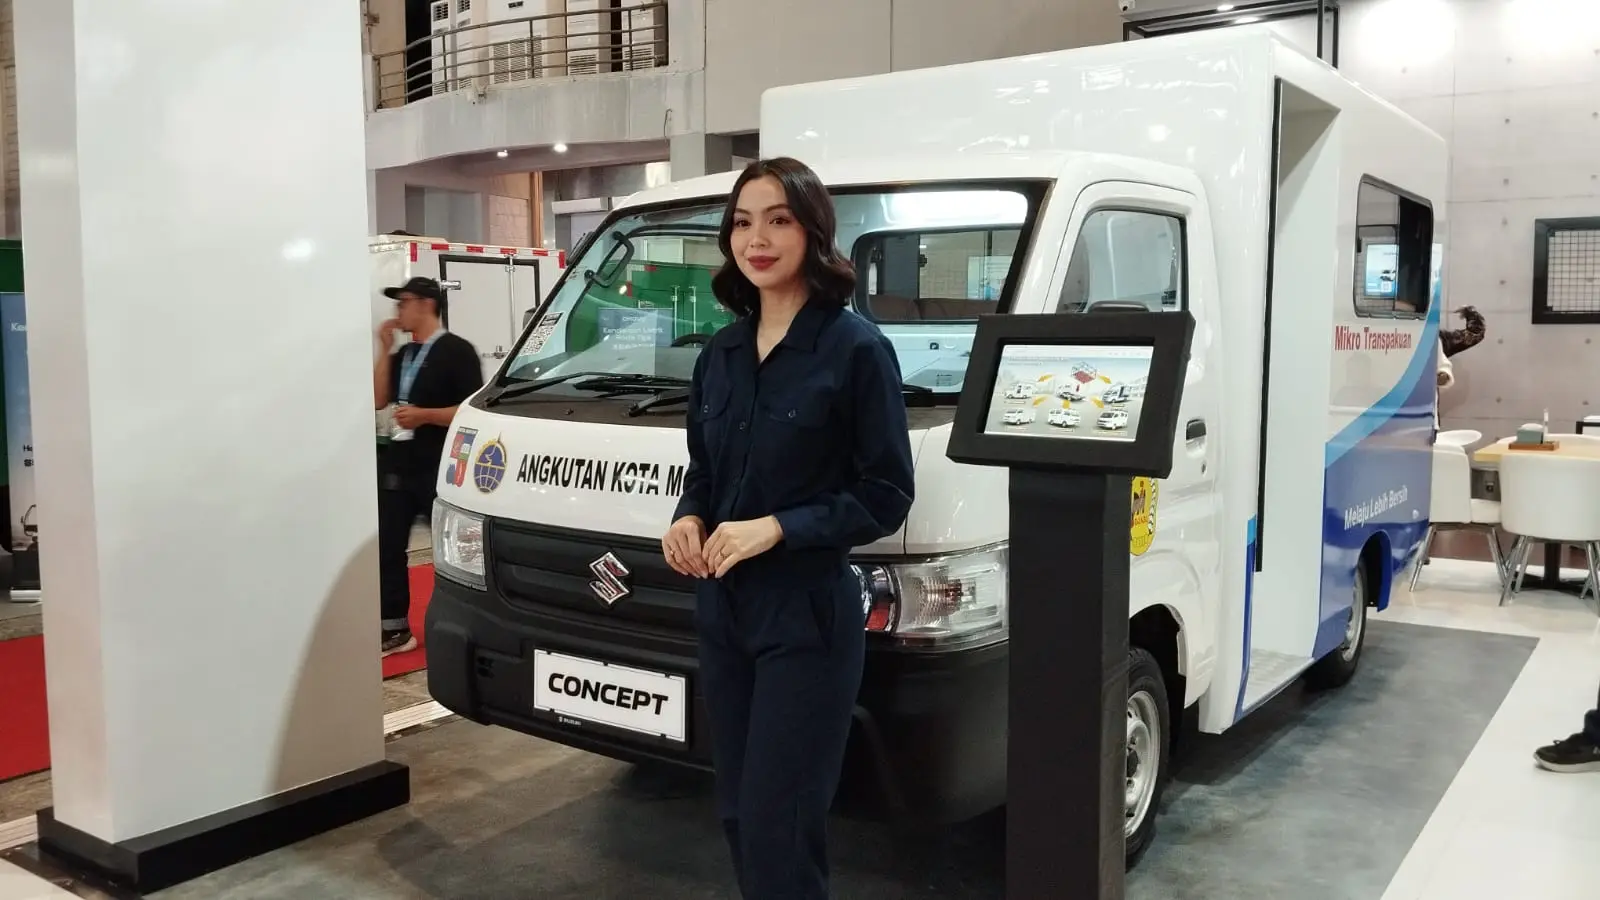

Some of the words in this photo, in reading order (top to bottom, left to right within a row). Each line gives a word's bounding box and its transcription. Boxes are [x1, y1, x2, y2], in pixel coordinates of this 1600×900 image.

[1334, 325, 1361, 351] Mikro
[1363, 326, 1412, 354] Transpakuan
[516, 453, 609, 491] ANGKUTAN
[611, 461, 660, 496] KOTA
[665, 464, 684, 497] M
[1344, 500, 1370, 531] Melaju
[1370, 492, 1389, 518] Lebih
[548, 672, 669, 716] CONCEPT
